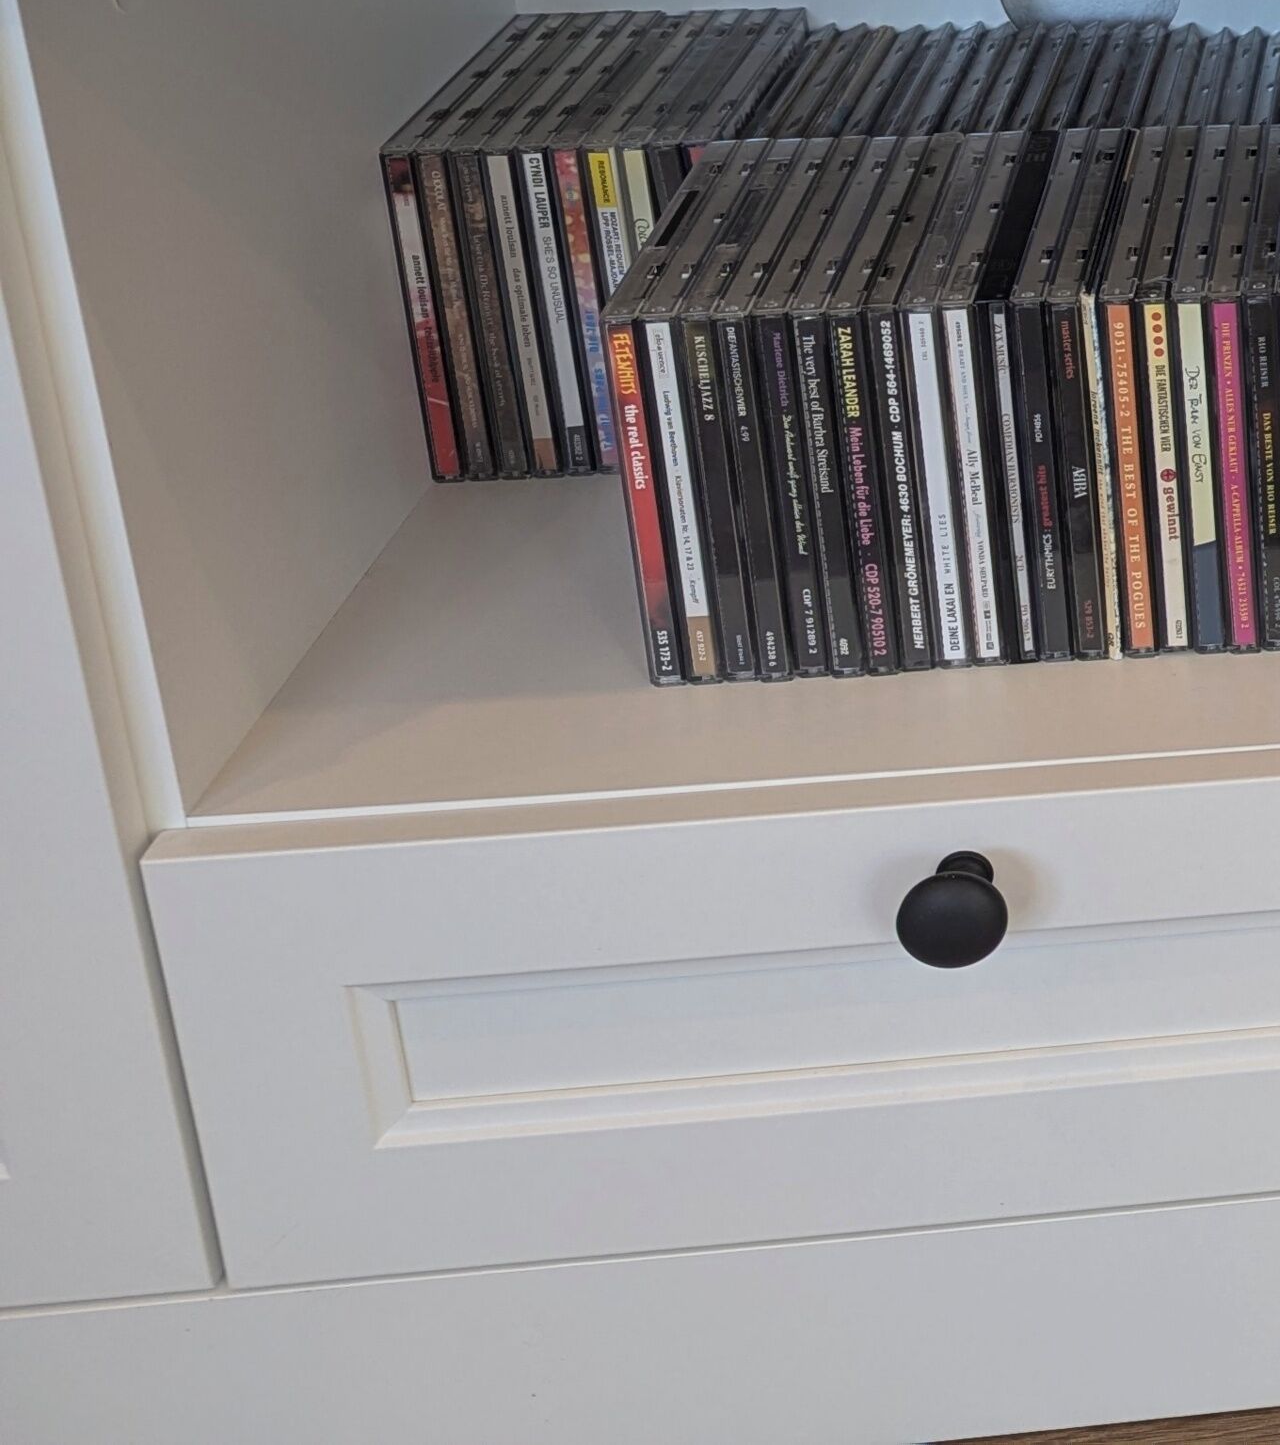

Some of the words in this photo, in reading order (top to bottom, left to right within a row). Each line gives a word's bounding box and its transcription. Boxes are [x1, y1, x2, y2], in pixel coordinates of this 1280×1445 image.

[527, 156, 544, 189] CYNDI
[597, 159, 610, 203] RESONANCE
[500, 194, 512, 224] annett
[533, 190, 551, 229] LAUPER
[505, 225, 518, 258] louisan
[411, 254, 424, 284] annett
[512, 267, 522, 282] das
[546, 265, 557, 279] SO
[416, 286, 430, 318] louisan
[513, 283, 529, 322] optimale
[549, 281, 566, 323] UNUSUAL
[521, 323, 533, 347] leben
[801, 334, 817, 354] The
[1060, 320, 1072, 352] master
[1220, 322, 1230, 337] DIE
[771, 331, 785, 368] Marlene
[836, 325, 855, 367] ZARAH
[1222, 340, 1232, 377] PRINZEN
[612, 331, 638, 396] FETENHITS
[691, 334, 714, 411] KUSCHELJAZZ
[801, 354, 817, 377] very
[1112, 321, 1130, 418] 9031-75405-2
[1154, 364, 1166, 376] DIE
[776, 369, 790, 406] Dietrich
[806, 377, 822, 399] best
[841, 367, 860, 418] LEANDER
[1224, 387, 1234, 412] ALLES
[622, 403, 641, 424] the
[810, 400, 823, 411] of
[887, 397, 901, 422] CDP
[1155, 377, 1170, 434] FANTASTISCHEN
[660, 390, 672, 415] Ludwig
[668, 430, 679, 466] Beethoven
[811, 412, 828, 447] Barbra
[1262, 412, 1271, 430] DAS
[626, 424, 644, 449] real
[848, 425, 864, 452] Mein
[1120, 425, 1132, 455] THE
[1159, 435, 1171, 452] VIER
[1263, 433, 1273, 460] BESTE
[851, 452, 868, 484] Leben
[890, 429, 907, 482] BOCHUM
[1227, 434, 1238, 473] GEKLAUT
[629, 449, 650, 490] classics
[815, 447, 834, 494] Streisand
[1036, 465, 1047, 484] hits
[1070, 464, 1088, 498] ABBA
[1122, 463, 1135, 499] BEST
[855, 484, 870, 500] für
[897, 483, 910, 512] 4630
[1266, 484, 1274, 501] RIO
[857, 500, 872, 517] die
[1126, 507, 1138, 527] OF
[1161, 485, 1181, 541] gewinnt
[1266, 504, 1276, 534] REISER
[859, 517, 875, 546] Liebe
[937, 513, 948, 537] LIES
[897, 513, 919, 596] GRÖNEMEYER:
[940, 544, 951, 574] WHITE
[1042, 533, 1056, 589] EURYTHMICS
[1128, 534, 1140, 563] THE
[1130, 570, 1146, 630] POGUES
[908, 596, 925, 649] HERBERT
[947, 625, 960, 650] DEINE
